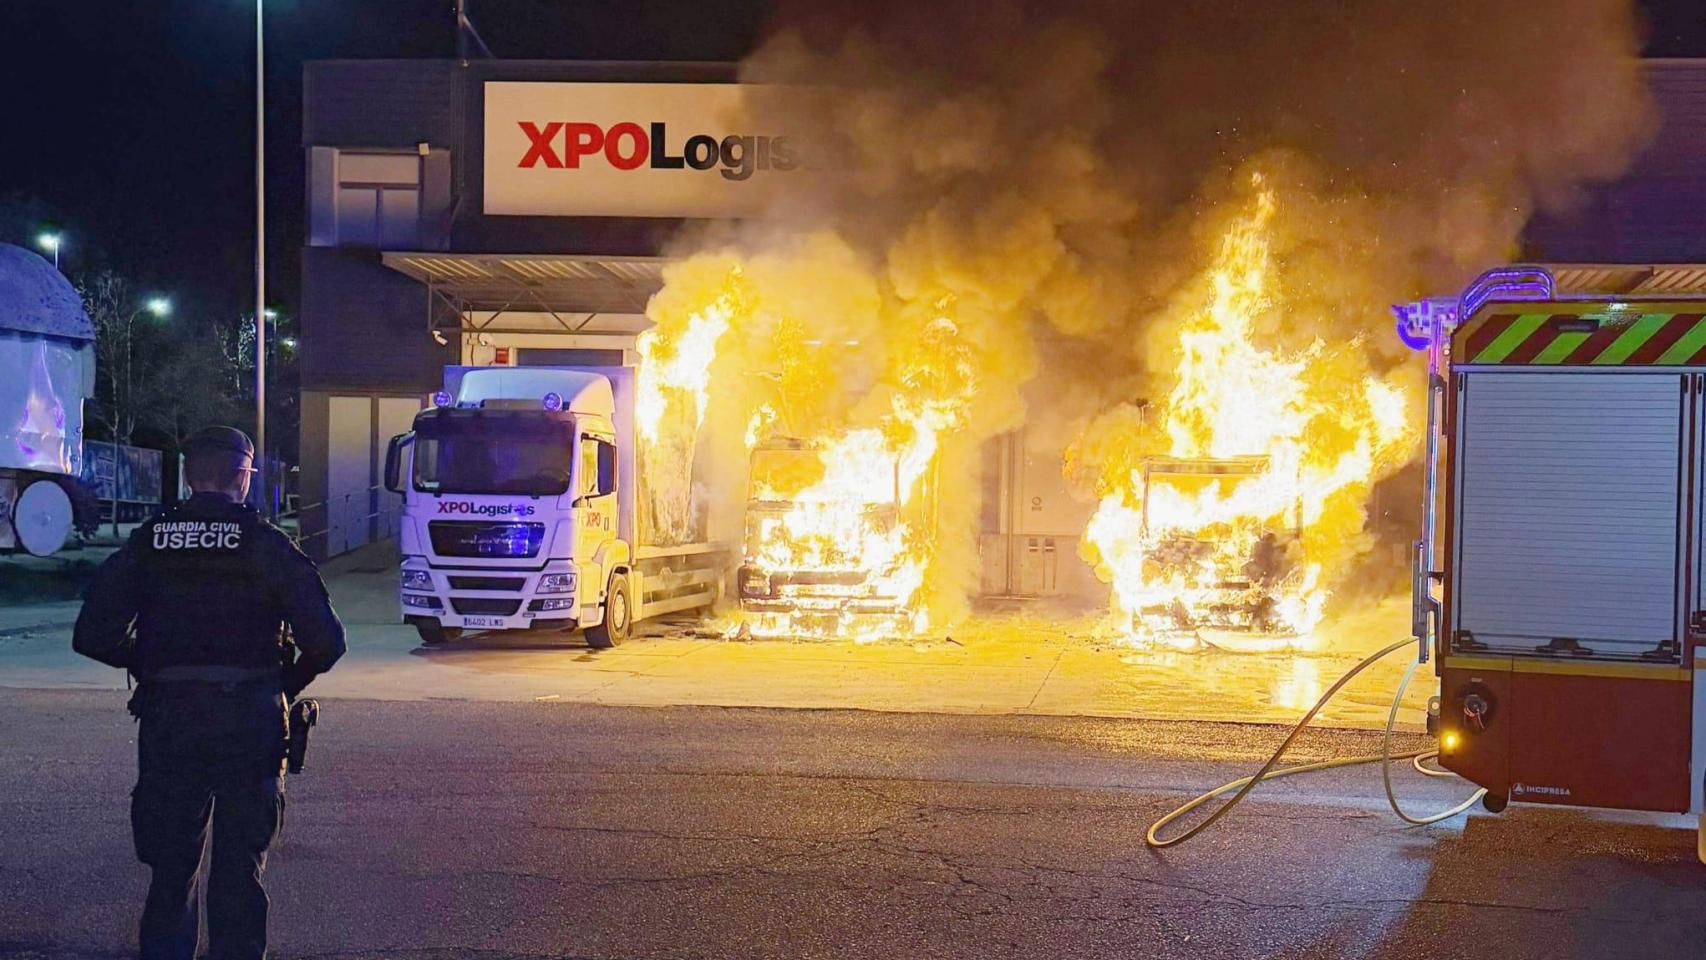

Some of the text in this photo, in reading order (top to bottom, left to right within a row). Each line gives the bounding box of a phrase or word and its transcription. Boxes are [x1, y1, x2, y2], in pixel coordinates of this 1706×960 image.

[517, 121, 800, 181] XPOLogis
[153, 522, 242, 533] GUARDIA CIVIL
[153, 532, 240, 549] USECIC
